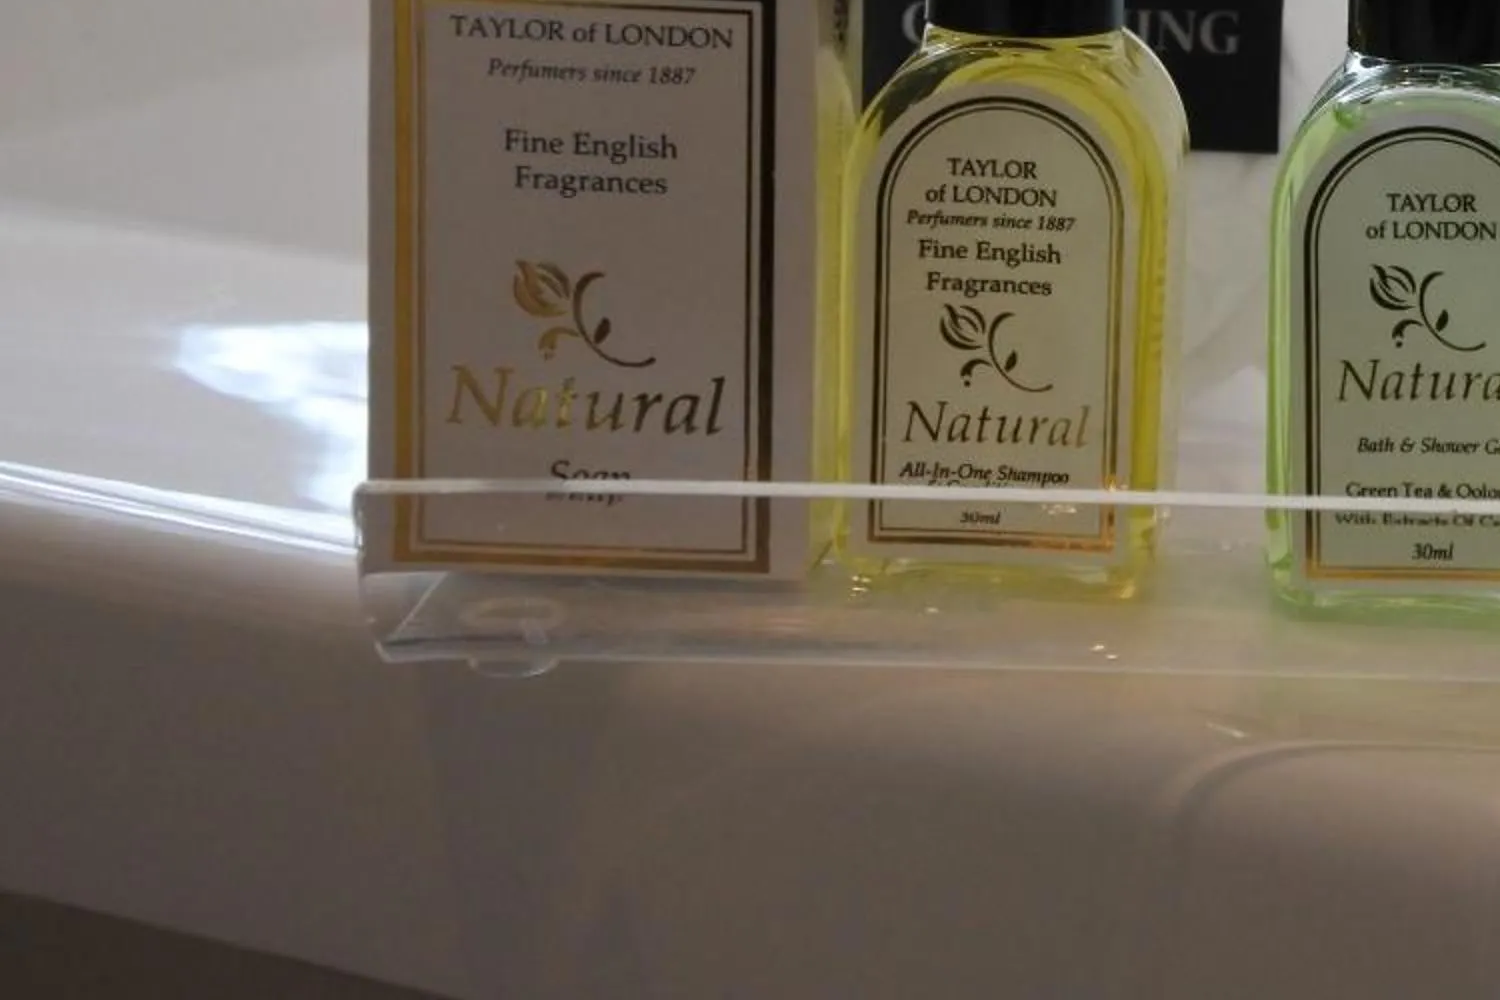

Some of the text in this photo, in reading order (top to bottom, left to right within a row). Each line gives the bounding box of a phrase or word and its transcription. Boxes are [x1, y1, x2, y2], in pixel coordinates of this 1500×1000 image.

[449, 14, 733, 50] TAYLOR of LONDON
[488, 58, 696, 85] Perfumers since 1887
[505, 129, 678, 165] Fine English
[515, 165, 668, 198] Fragrances
[947, 157, 1037, 180] TAYLOR
[925, 184, 1057, 208] of LONDON
[1386, 193, 1478, 214] TAYLOR
[907, 209, 1076, 232] Perfumers since 1887
[1366, 220, 1497, 241] of LONDON
[918, 239, 1061, 269] Fine English
[927, 271, 1053, 298] Fragrances
[446, 364, 725, 436] Natural
[902, 400, 1091, 449] Natural
[1357, 436, 1394, 455] Bath
[1400, 437, 1416, 454] &
[1421, 437, 1482, 455] Shower
[899, 461, 993, 481] All-In-One
[996, 464, 1070, 487] Shampoo
[1345, 481, 1398, 499] Green
[1401, 482, 1434, 499] Tea
[1437, 483, 1452, 499] &
[1411, 542, 1455, 561] 30ml
